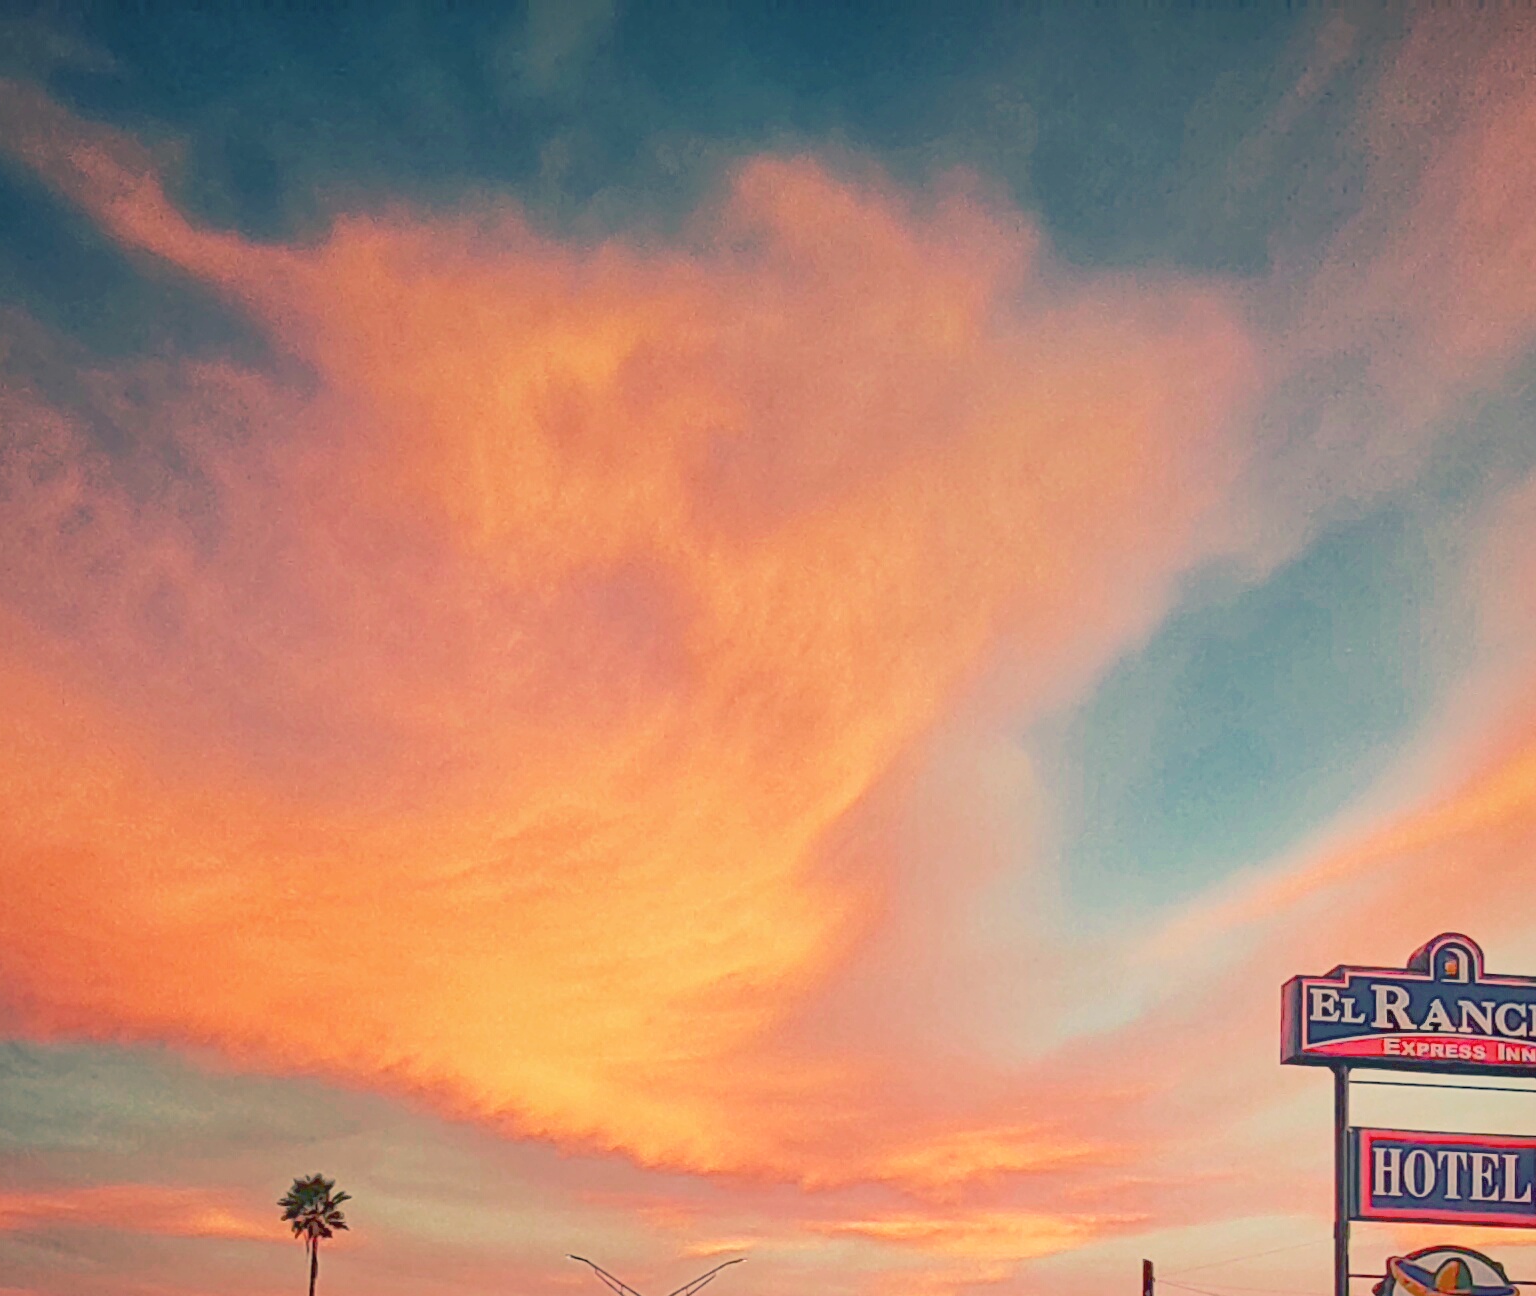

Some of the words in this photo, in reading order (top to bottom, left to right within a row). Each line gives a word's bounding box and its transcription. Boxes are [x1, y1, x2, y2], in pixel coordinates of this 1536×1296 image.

[1309, 988, 1366, 1024] EL
[1383, 1037, 1486, 1060] EXPRESS
[1497, 1042, 1536, 1063] INN
[1373, 1147, 1532, 1203] HOTEL
